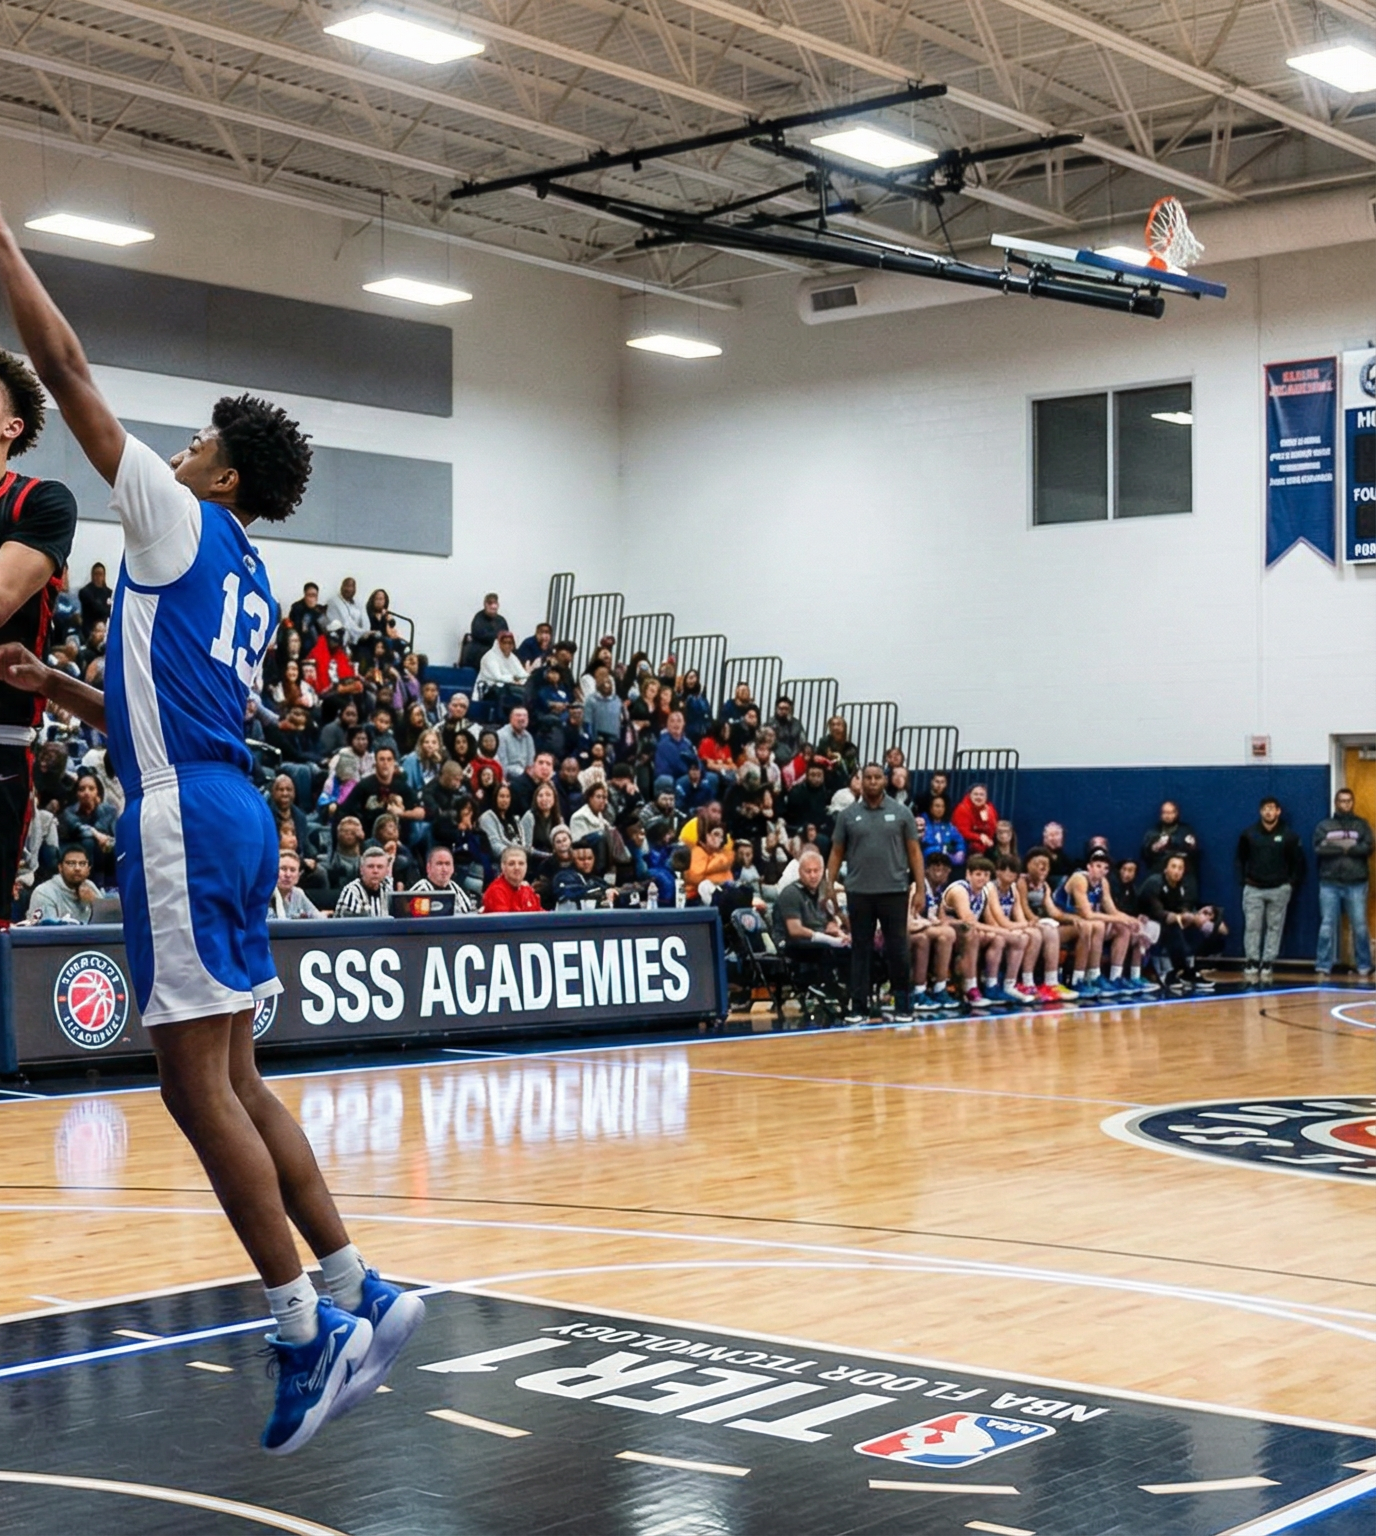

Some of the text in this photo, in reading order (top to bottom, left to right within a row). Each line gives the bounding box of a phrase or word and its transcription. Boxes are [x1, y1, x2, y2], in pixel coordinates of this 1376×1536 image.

[210, 571, 270, 688] 13
[299, 935, 691, 1025] SSS ACADEMIES
[415, 1337, 899, 1443] TIER 1
[818, 1364, 988, 1401] FLOOR
[990, 1392, 1111, 1423] NBA
